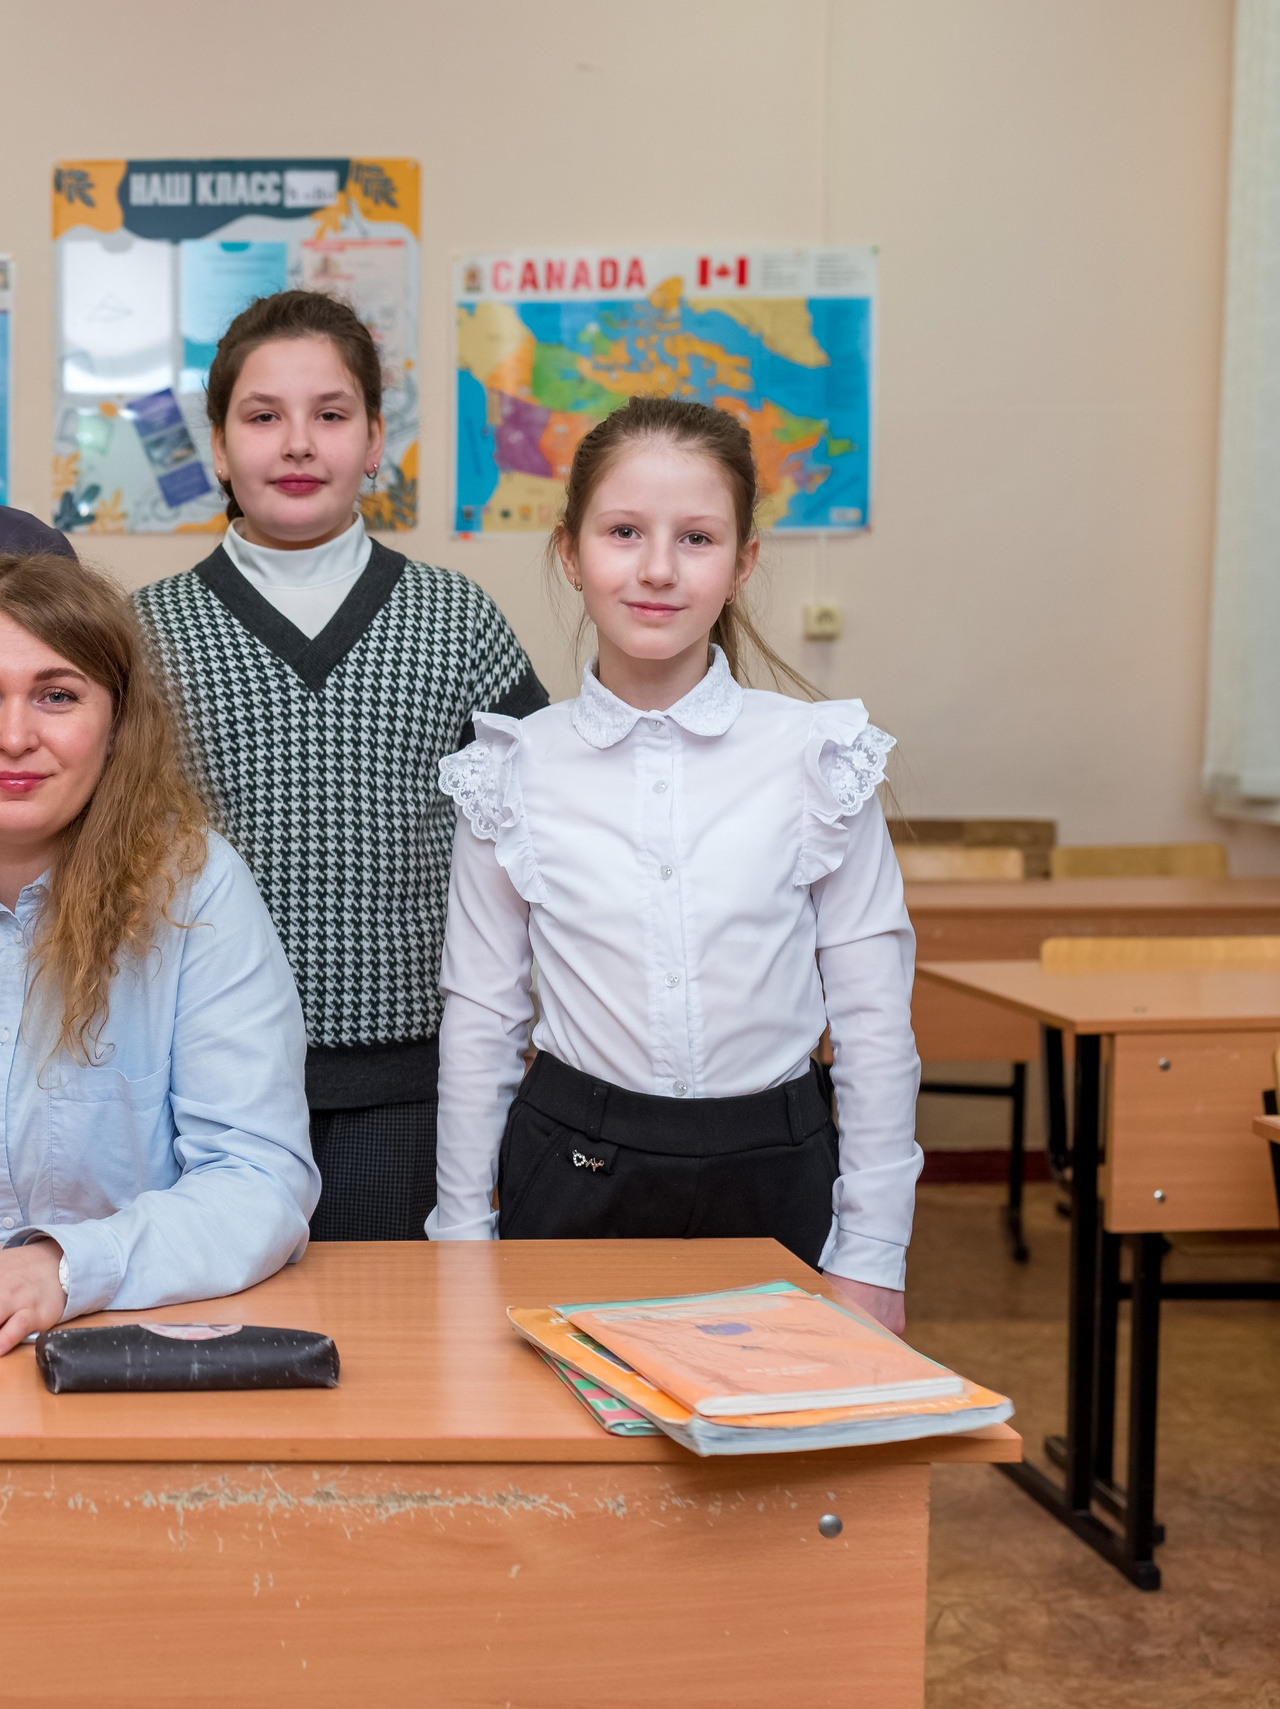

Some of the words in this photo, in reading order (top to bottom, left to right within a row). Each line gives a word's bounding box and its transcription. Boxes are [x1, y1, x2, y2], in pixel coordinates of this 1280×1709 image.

[129, 172, 192, 206] НАШ
[196, 171, 281, 206] КЛАСС
[491, 256, 646, 293] CANADA
